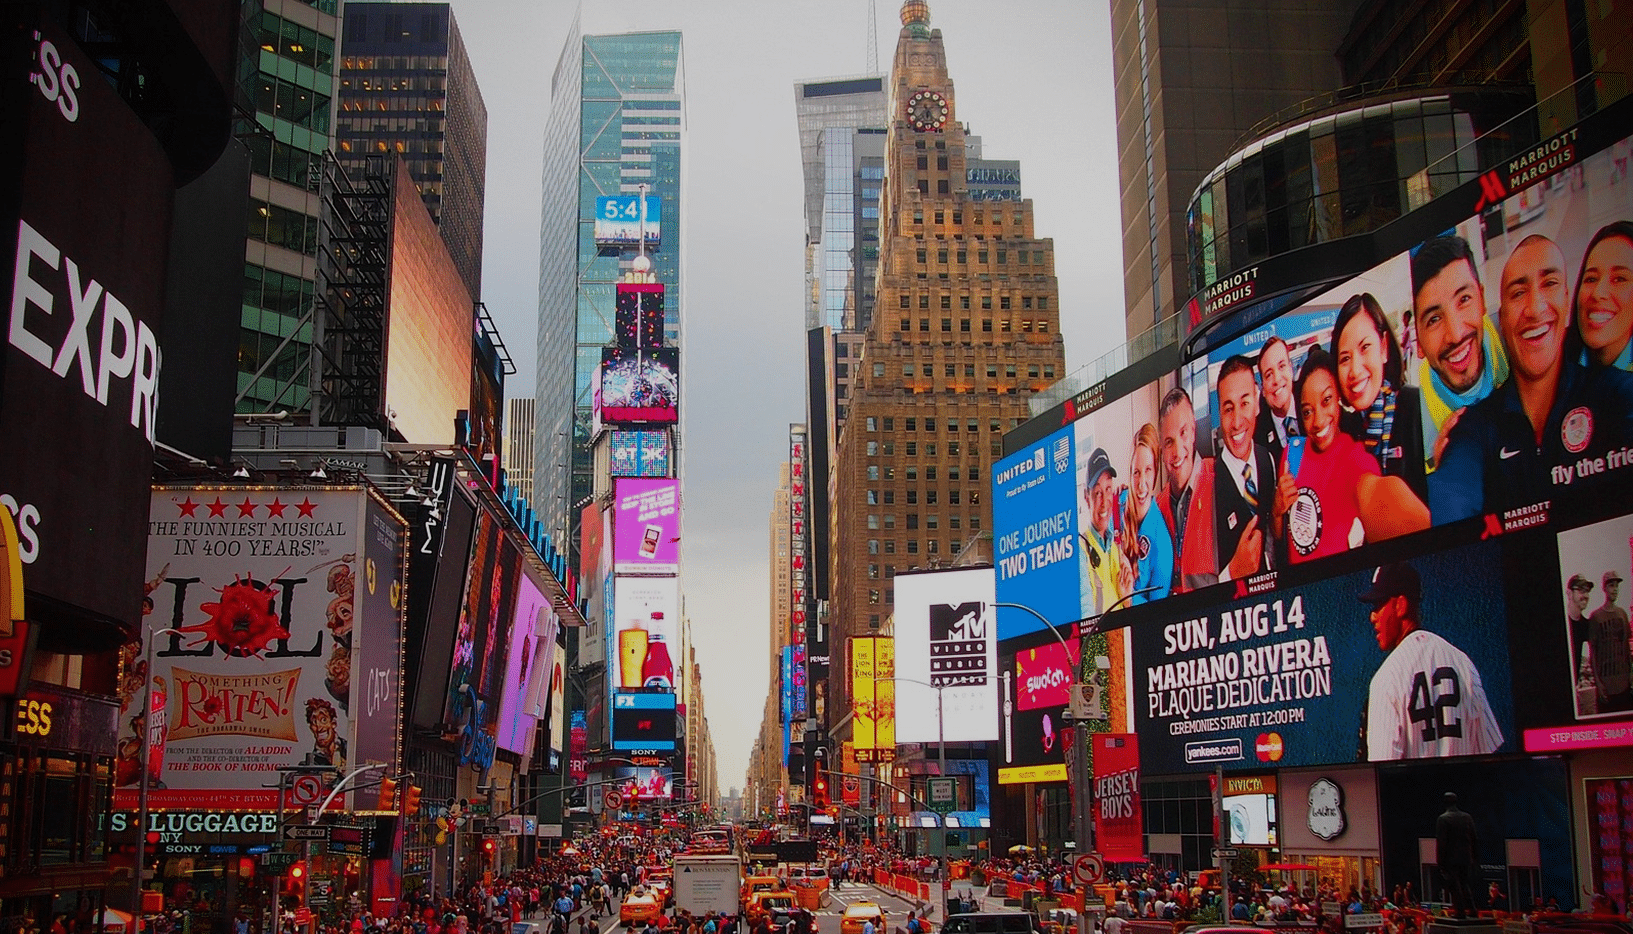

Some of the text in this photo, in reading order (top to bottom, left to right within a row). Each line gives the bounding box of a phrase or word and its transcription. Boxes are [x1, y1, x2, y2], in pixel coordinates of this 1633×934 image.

[1508, 128, 1579, 174] MARRIOTT
[1510, 149, 1572, 189] MARQUIS
[1203, 267, 1259, 301] MARRIOTT
[1204, 285, 1252, 315] MARQUIS
[1244, 331, 1270, 347] UNITED
[1076, 382, 1107, 404] MARRIOTT
[1077, 394, 1104, 414] MARQUIS
[327, 458, 366, 469] LAMAR
[997, 459, 1033, 485] UNITED
[1551, 465, 1574, 485] fly
[1576, 457, 1605, 478] the
[1504, 501, 1550, 519] MARRIOTT
[148, 522, 347, 536] THE FUNNIEST MUSICAL
[1504, 513, 1546, 531] MARQUIS
[999, 509, 1072, 555] ONE JOURNEY
[174, 540, 198, 556] IN
[203, 540, 241, 556] 400
[999, 534, 1073, 580] TWO TEAMS
[1248, 571, 1278, 585] MARRIOTT
[1248, 581, 1275, 593] MARQUIS
[930, 600, 986, 641] MTV
[1164, 595, 1305, 655] SUN, AUG 14
[933, 643, 983, 653] VIDEO
[854, 668, 873, 678] KING
[933, 660, 983, 669] MUSIC
[1147, 636, 1332, 692] MARIANO RIVERA
[189, 674, 282, 688] SOMETHING
[933, 675, 983, 686] AWARDS
[367, 668, 390, 717] CATS
[617, 695, 635, 707] FX
[1148, 666, 1332, 719] PLAQUE DEDICATION
[174, 677, 296, 732] ROTTEN!
[1407, 666, 1463, 743] 42
[1169, 708, 1304, 736] CEREMONIES START AT 12:00 PM
[1550, 732, 1571, 743] STEP
[244, 746, 292, 755] ALADDIN
[1187, 743, 1240, 760] yankees.com
[168, 763, 189, 771] THE
[192, 763, 222, 771] BOOK
[224, 763, 239, 771] OF
[1095, 770, 1139, 799] JERSEY
[1228, 778, 1264, 792] INVICTA
[1101, 794, 1133, 819] BOYS
[148, 814, 278, 833] LUGGAGE
[296, 829, 324, 837] ONE WAY
[165, 845, 203, 854] SONY
[270, 855, 292, 864] W 46
